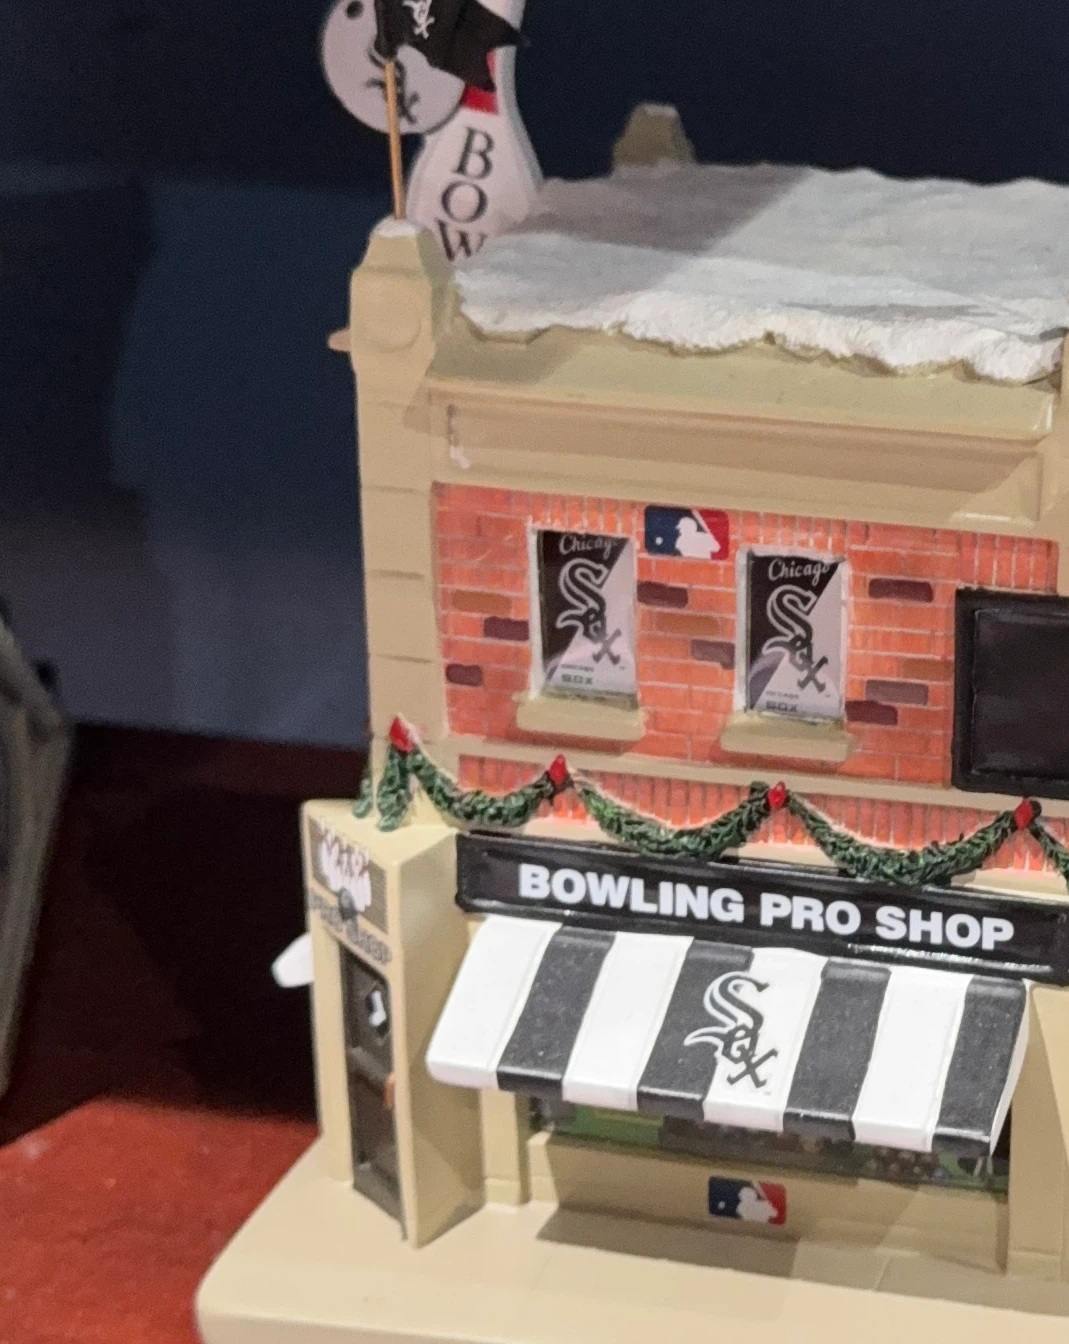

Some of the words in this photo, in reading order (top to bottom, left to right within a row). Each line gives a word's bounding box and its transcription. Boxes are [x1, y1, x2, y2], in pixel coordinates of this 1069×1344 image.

[518, 863, 745, 923] BOWLING
[760, 892, 862, 936] PRO
[875, 905, 1015, 951] SHOP
